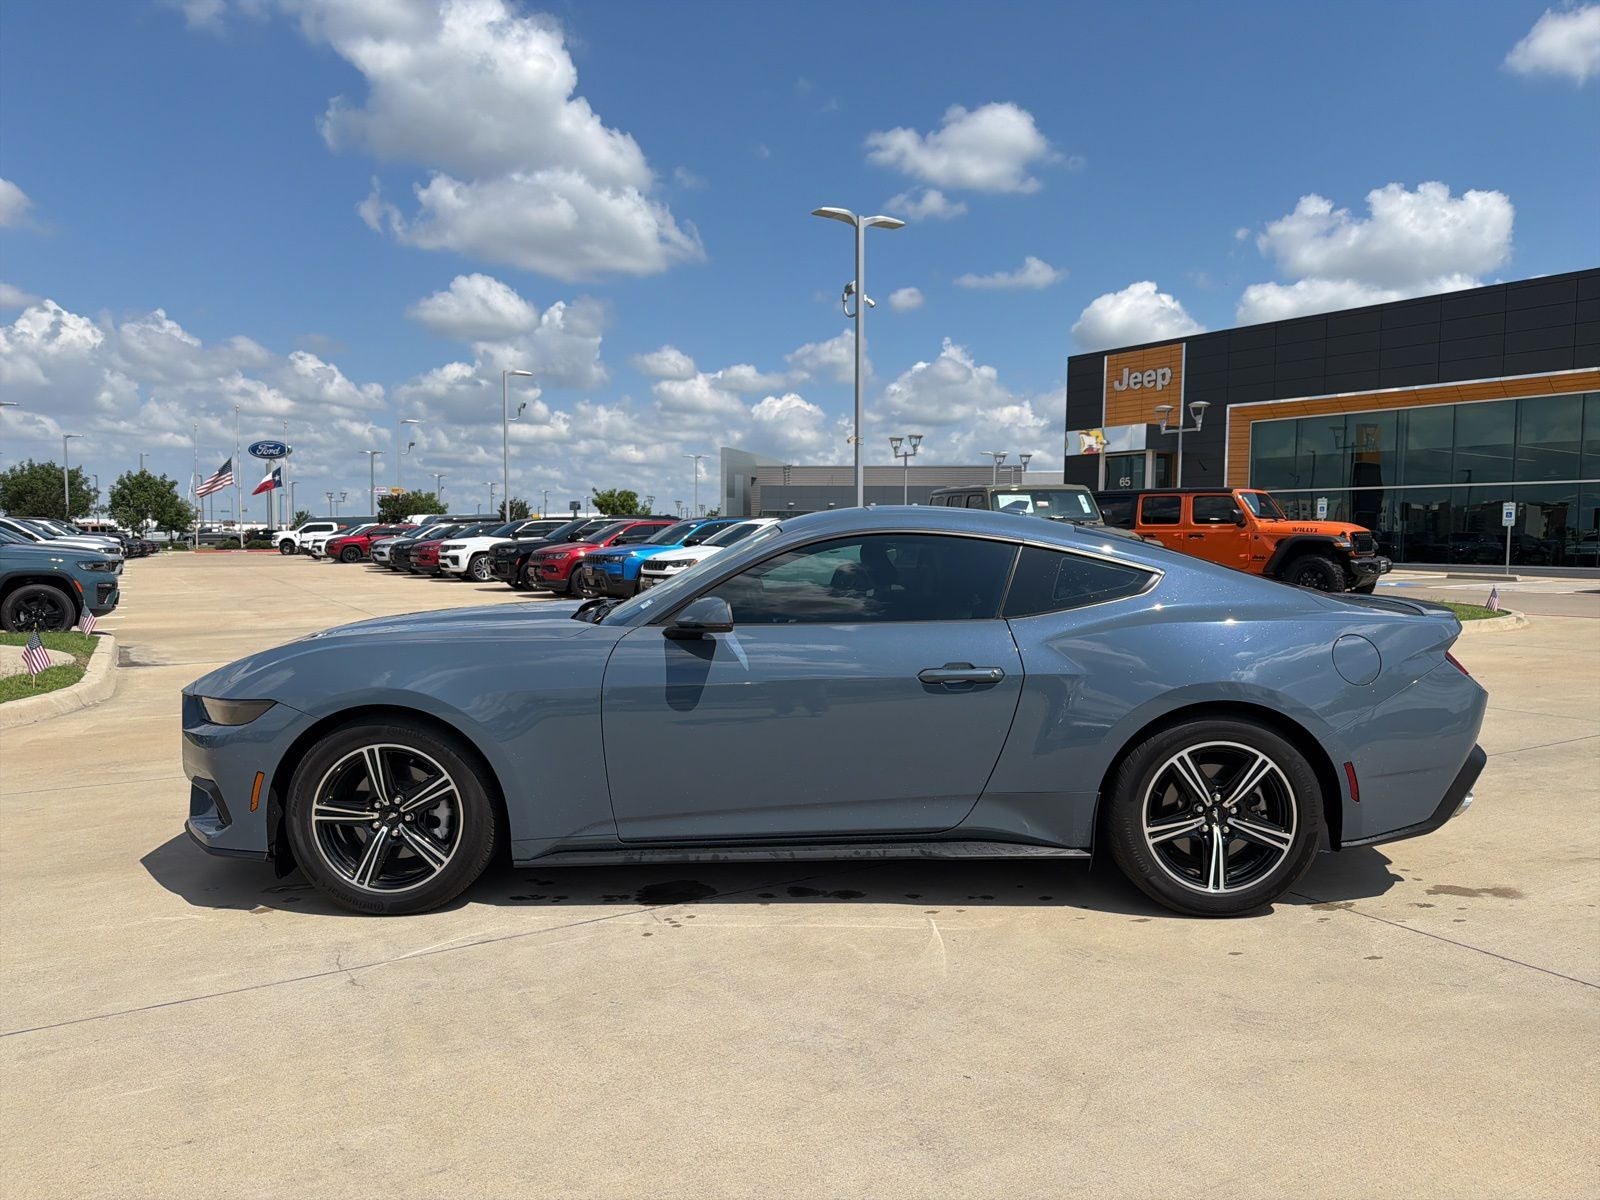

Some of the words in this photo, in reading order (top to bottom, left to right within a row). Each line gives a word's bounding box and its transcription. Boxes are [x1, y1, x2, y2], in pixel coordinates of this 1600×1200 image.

[1114, 367, 1172, 391] Jeep
[256, 444, 281, 455] Ford
[1119, 476, 1131, 487] 65
